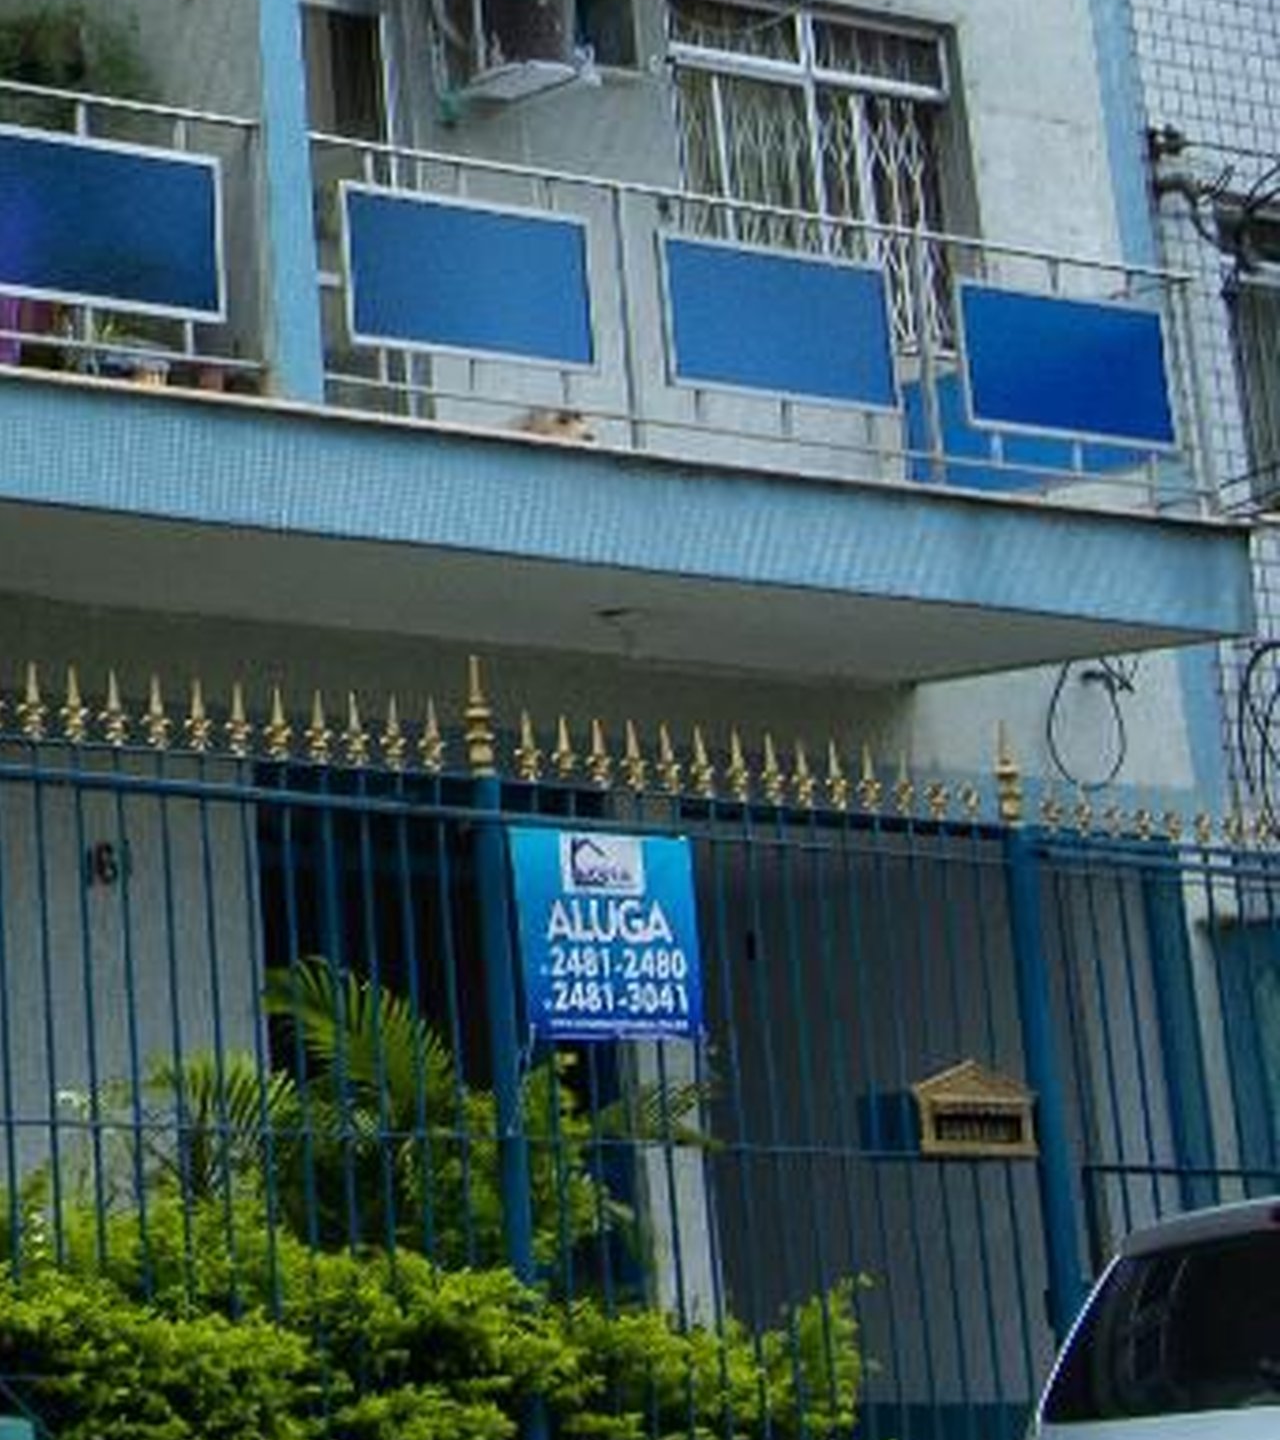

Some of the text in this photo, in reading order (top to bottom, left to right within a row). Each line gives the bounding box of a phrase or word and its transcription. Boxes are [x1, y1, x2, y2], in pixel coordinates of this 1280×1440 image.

[548, 898, 674, 944] ALUGA
[551, 945, 687, 980] 2481-2480
[553, 980, 689, 1015] 2481-3041
